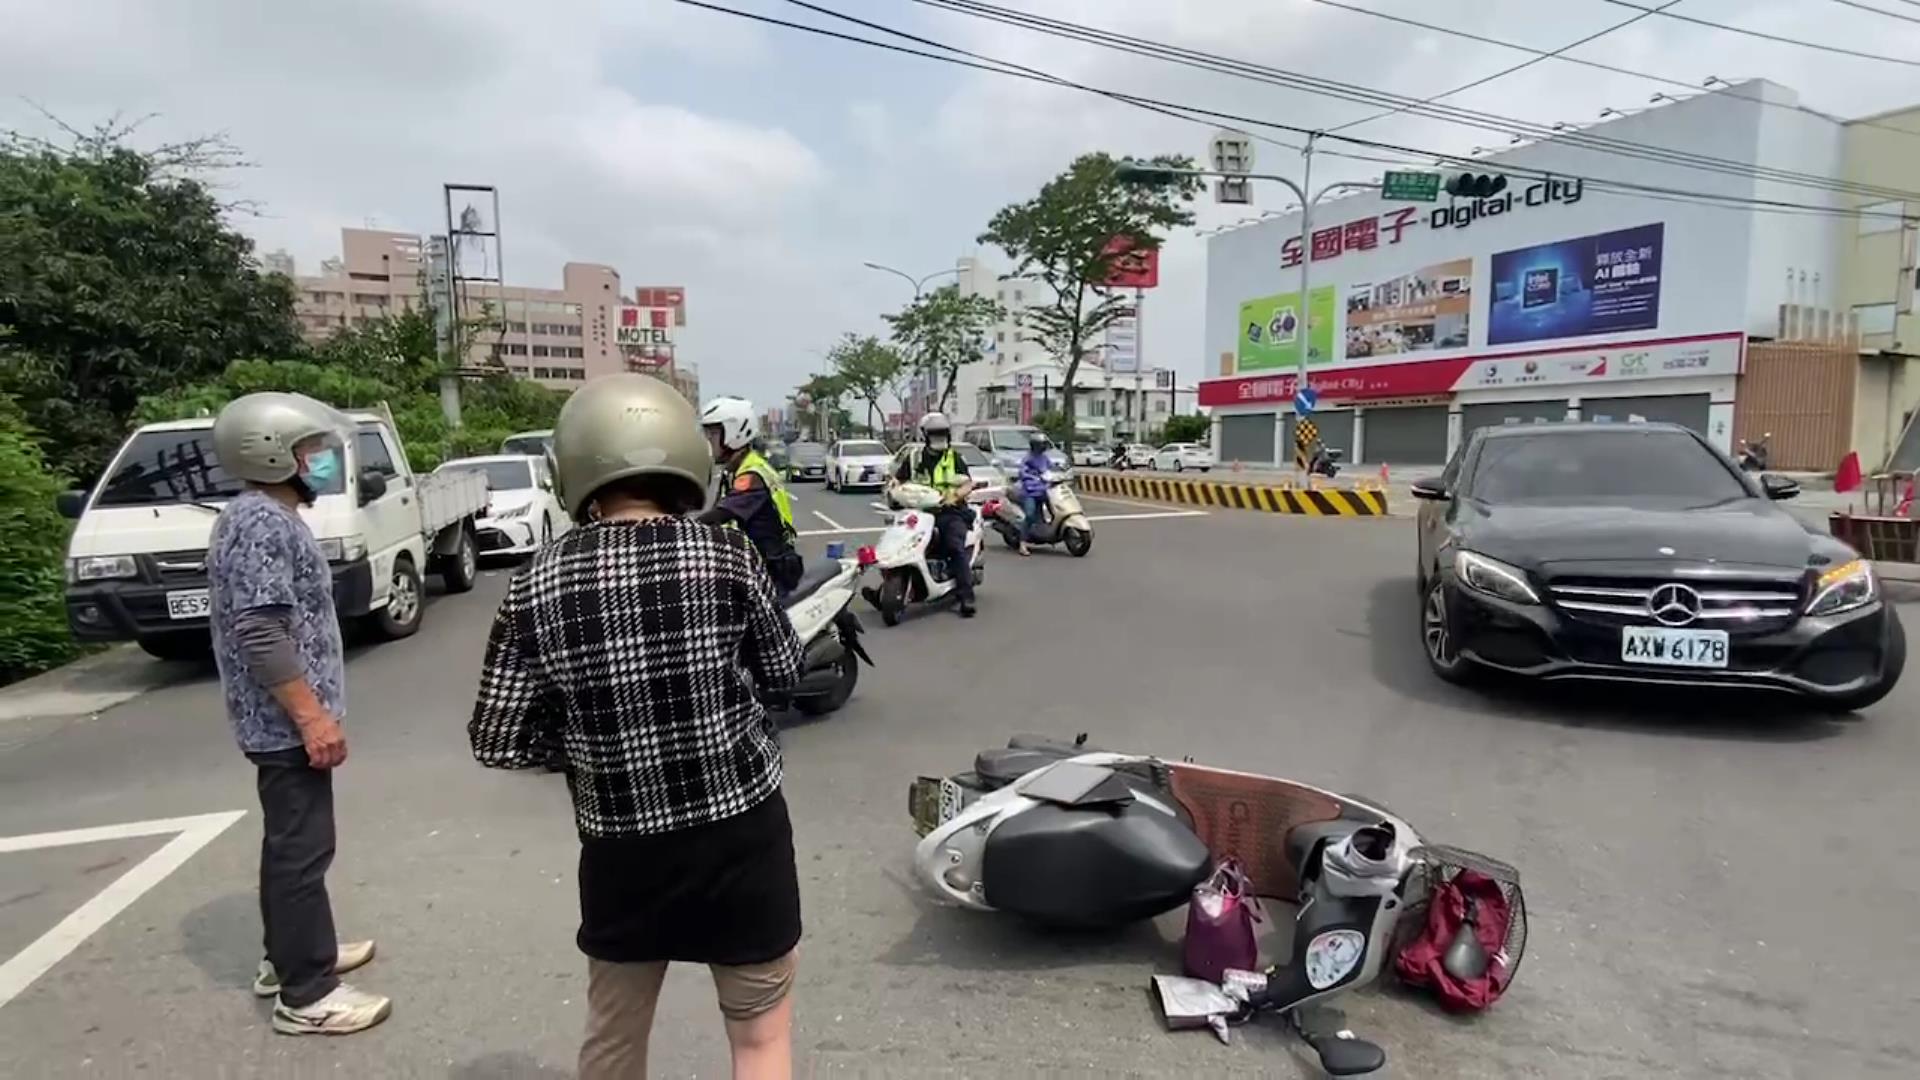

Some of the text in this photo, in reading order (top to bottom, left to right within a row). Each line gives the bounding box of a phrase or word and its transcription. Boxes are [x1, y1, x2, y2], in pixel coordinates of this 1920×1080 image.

[1281, 207, 1418, 269] 全國電子
[1595, 267, 1610, 280] AI
[617, 328, 672, 344] MOTEL
